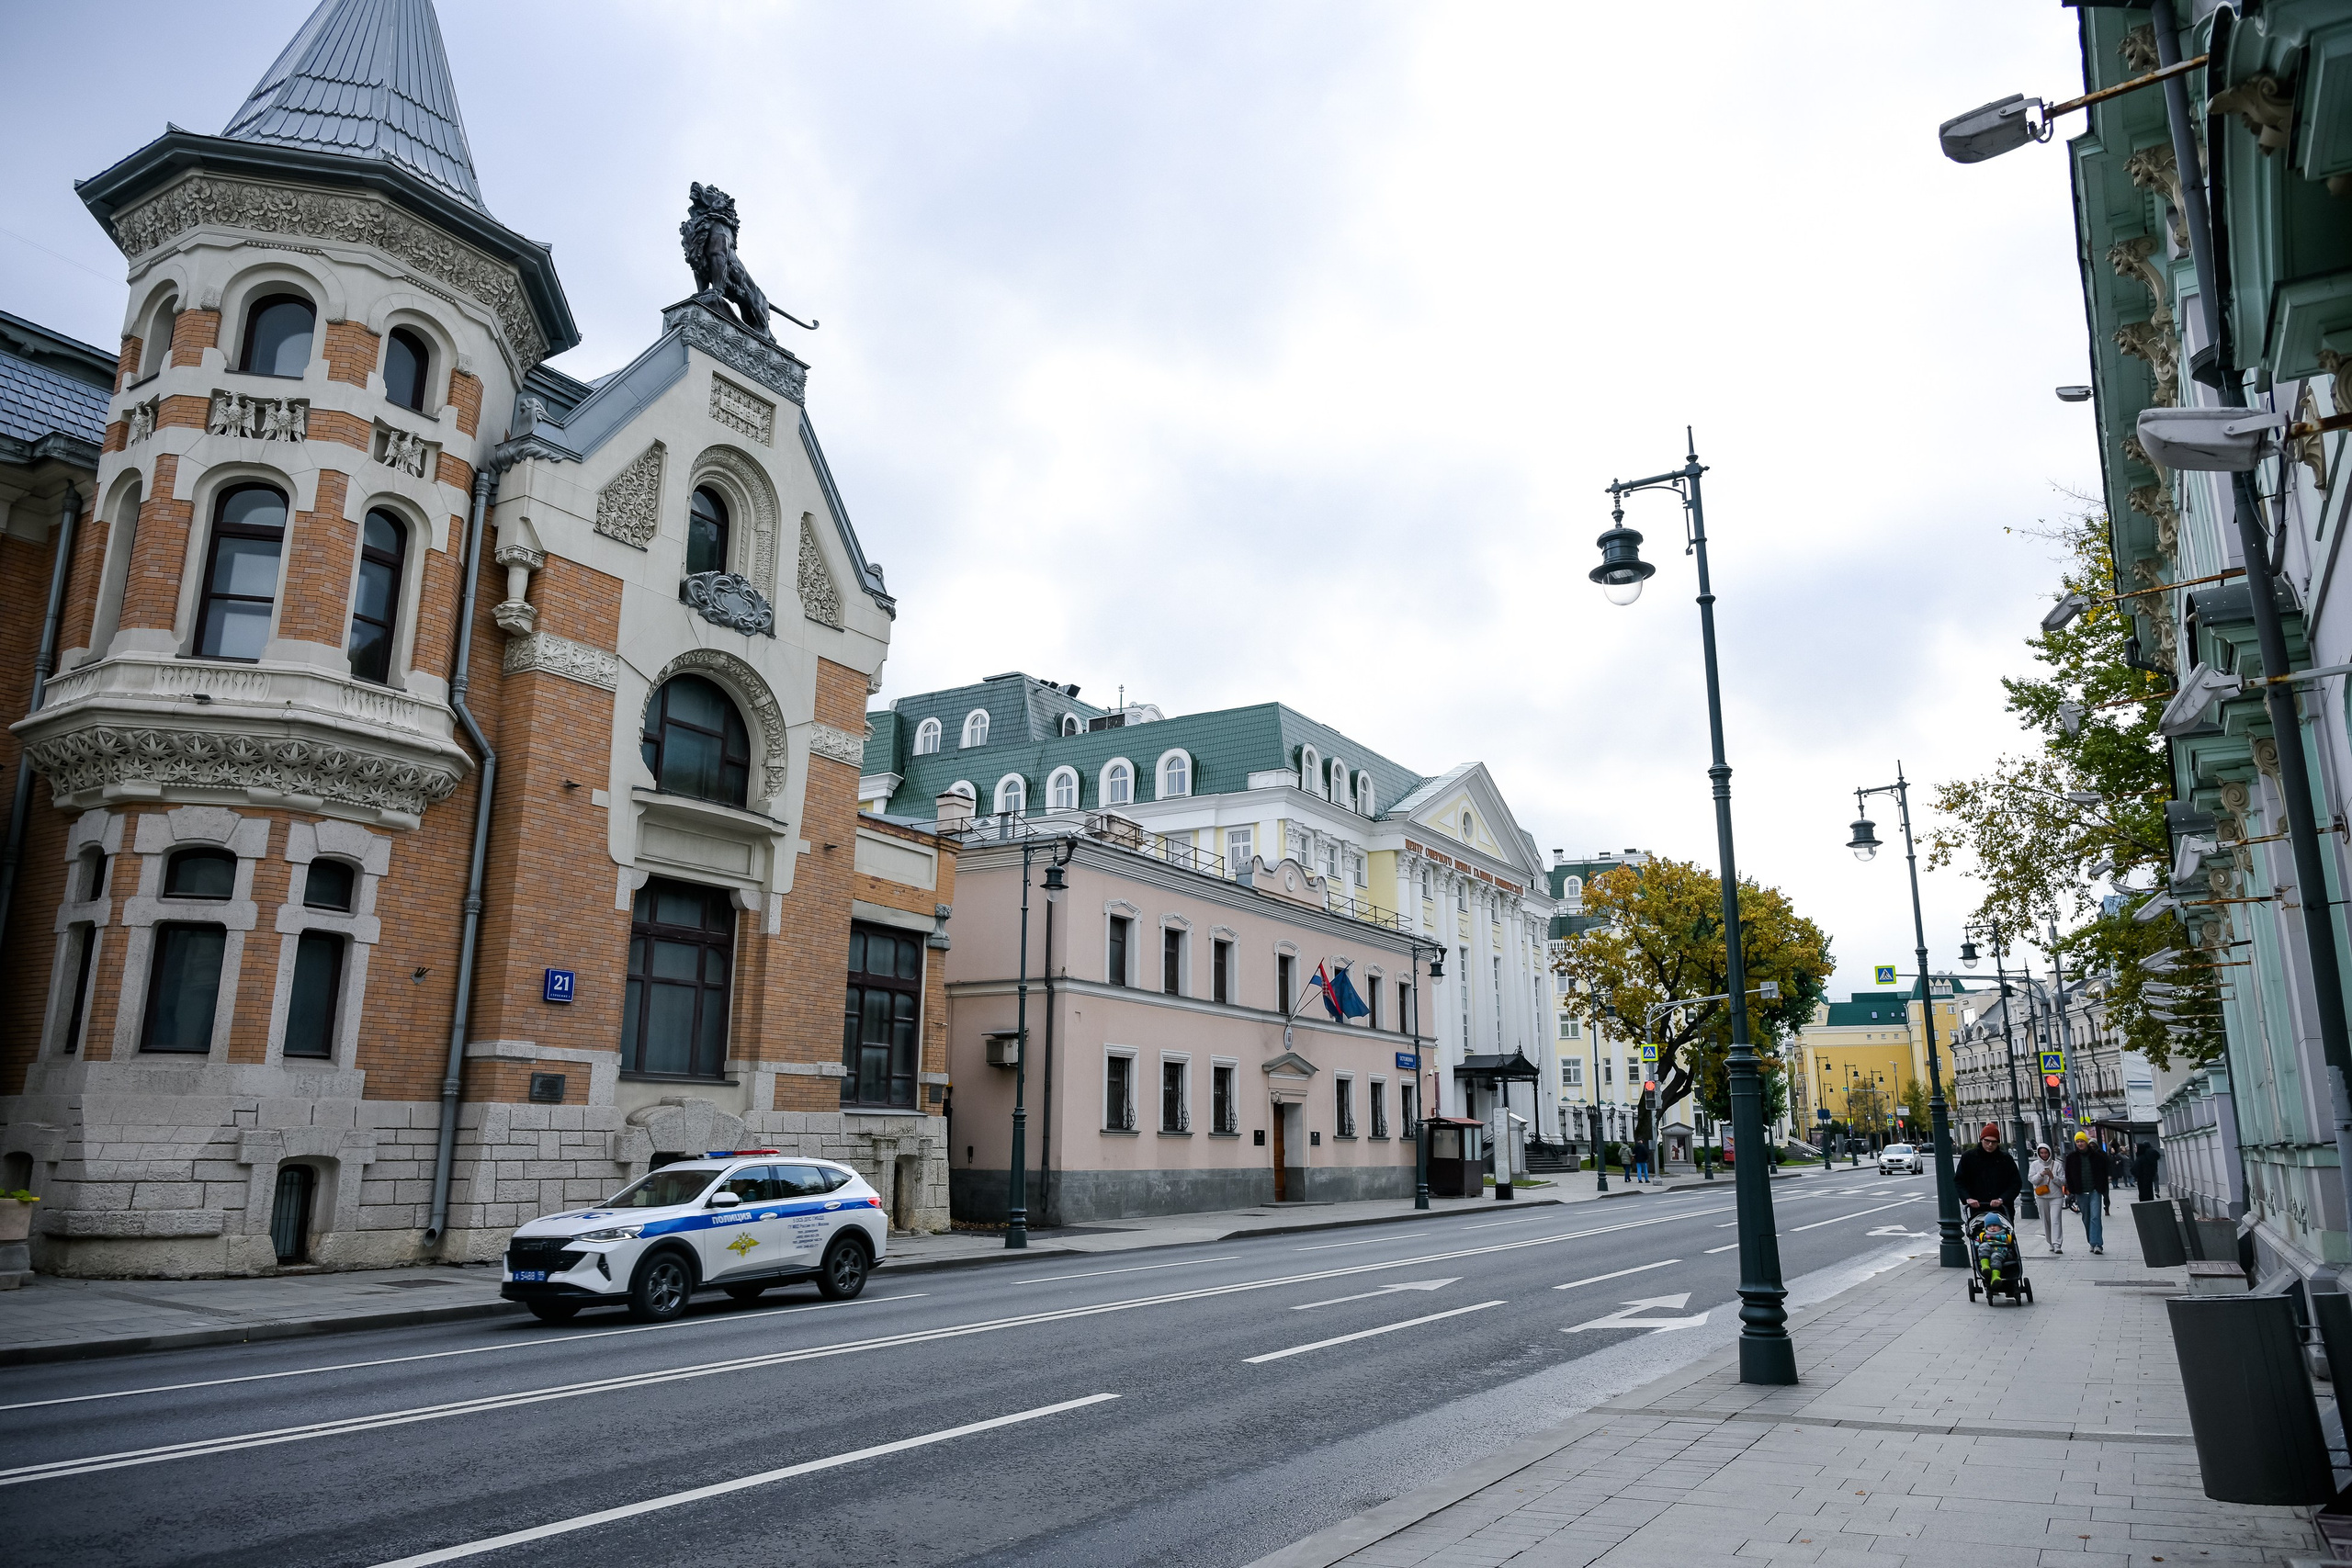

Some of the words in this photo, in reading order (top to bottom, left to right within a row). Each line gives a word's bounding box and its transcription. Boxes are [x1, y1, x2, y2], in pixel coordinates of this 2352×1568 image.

[1405, 838, 1423, 854] ЦЕНТР
[1425, 847, 1453, 866] ОПЕРНОГО
[1454, 859, 1472, 874] ПЕНИЯ
[1474, 867, 1494, 884] ГАЛИНЫ
[553, 975, 570, 991] 21
[711, 1212, 752, 1224] ПОЛИЦИЯ
